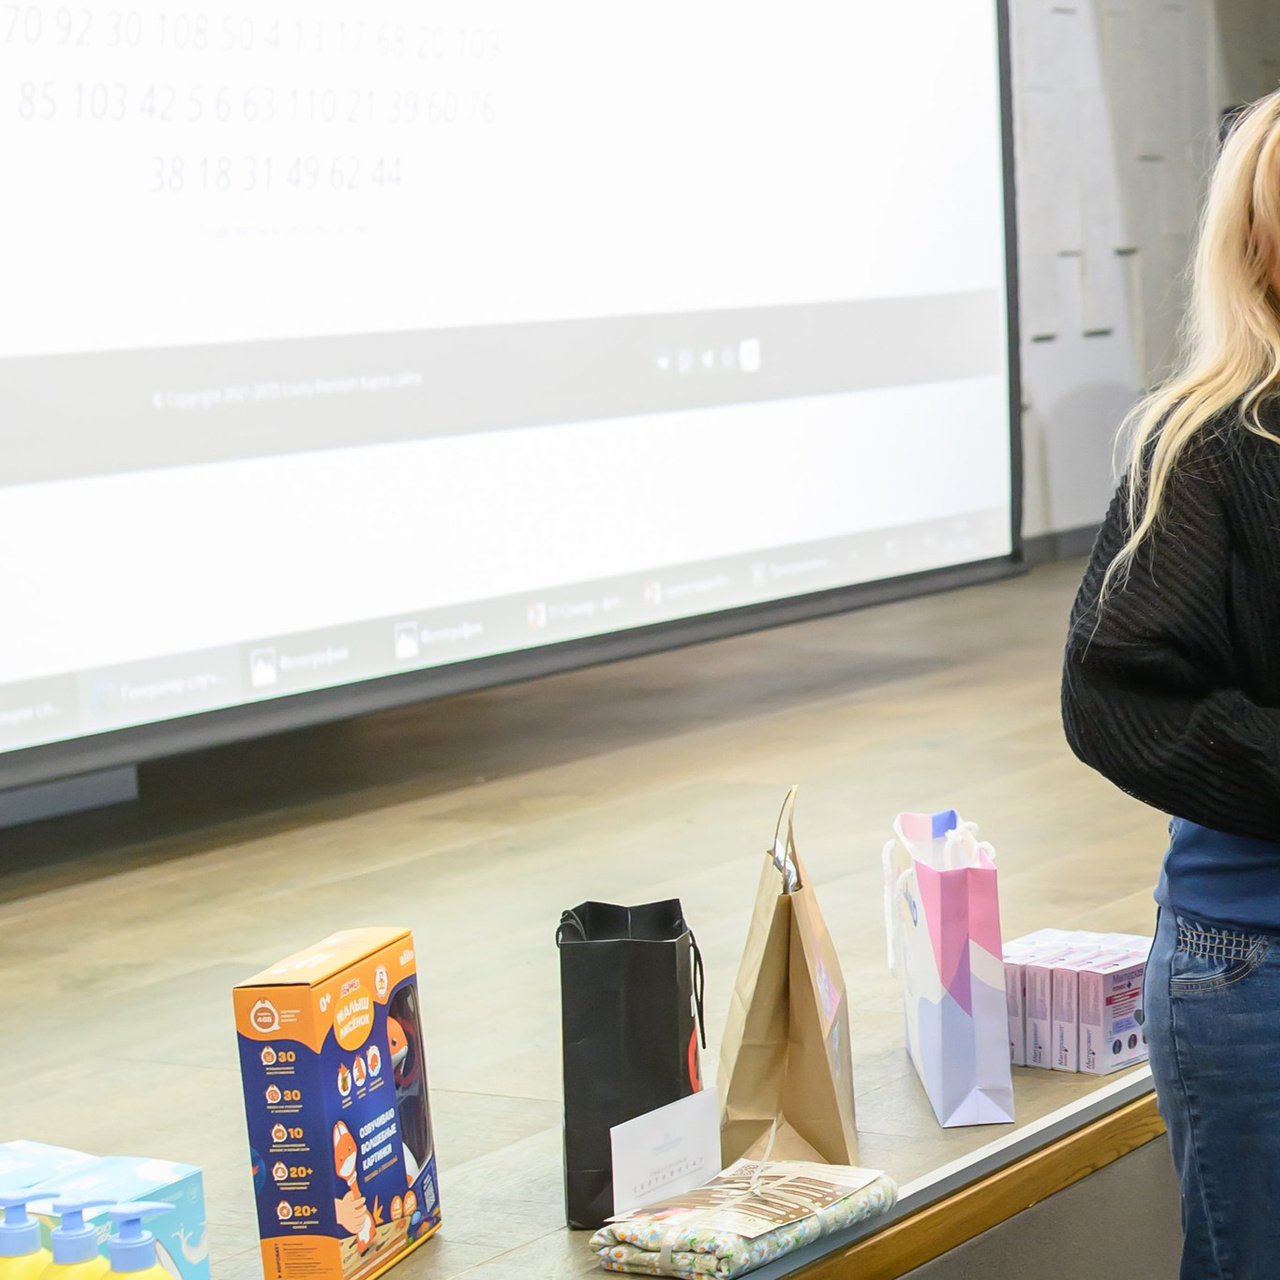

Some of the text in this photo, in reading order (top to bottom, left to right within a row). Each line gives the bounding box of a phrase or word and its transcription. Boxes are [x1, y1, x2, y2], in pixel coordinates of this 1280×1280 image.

[3, 4, 501, 62] 70 92 30 108 50 4 13 17 68 20 109
[17, 81, 497, 125] 85 103 42 5 6 63 110 21 39 60 76
[150, 155, 403, 194] 38 18 31 49 62 44
[319, 993, 331, 1013] 0+
[336, 996, 369, 1025] МАЛЫШ
[278, 1051, 296, 1063] 30
[283, 1089, 301, 1101] 30
[288, 1127, 303, 1139] 10
[359, 1107, 396, 1139] ОЗВУЧИВАЮ
[360, 1122, 397, 1156] ВОЛШЕБНЫЕ
[362, 1143, 393, 1171] КАРТИНКИ
[289, 1166, 314, 1178] 20+
[293, 1205, 318, 1217] 20+
